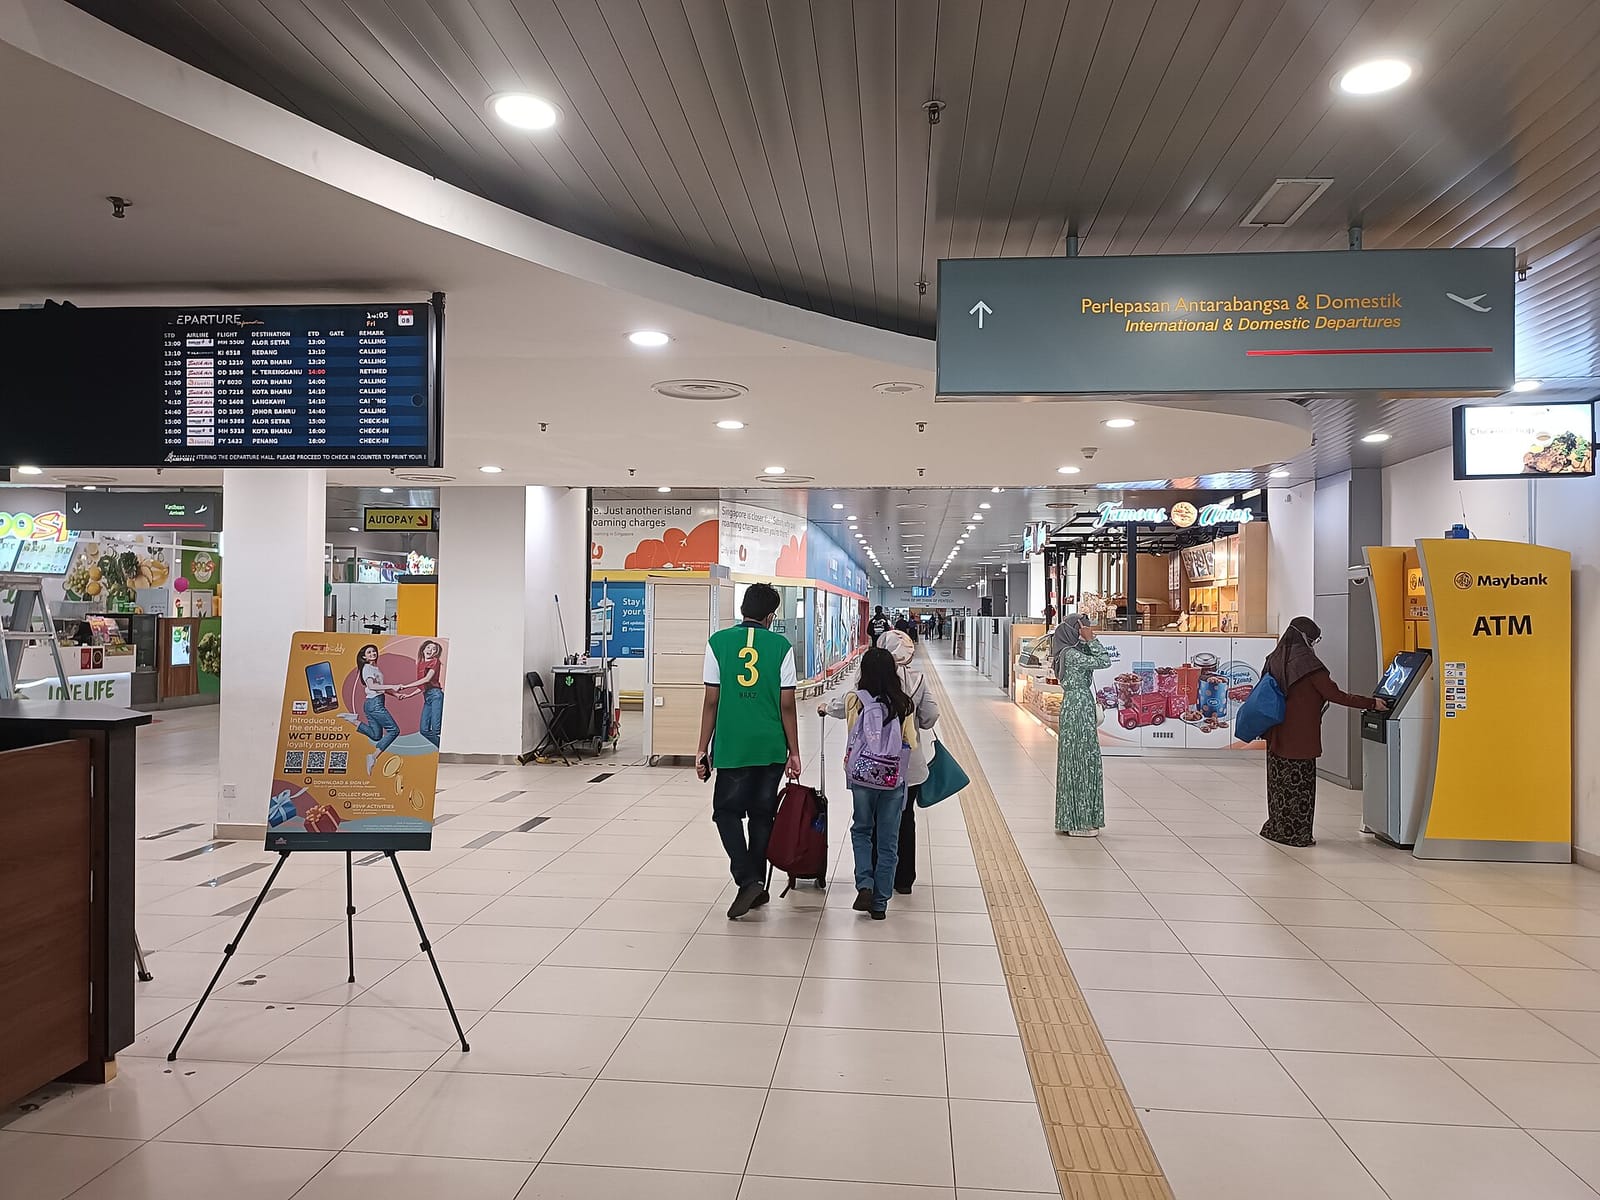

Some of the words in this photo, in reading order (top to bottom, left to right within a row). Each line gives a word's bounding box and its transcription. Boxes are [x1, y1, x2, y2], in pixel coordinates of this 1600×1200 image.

[1081, 298, 1170, 317] Perlepasan
[1174, 295, 1290, 315] Antarabangsa
[1295, 295, 1310, 310] &
[1315, 292, 1402, 310] Domestik
[168, 314, 242, 325] EPARTURE
[1125, 318, 1219, 332] International
[1222, 318, 1234, 331] &
[1238, 317, 1311, 331] Domestic
[1315, 316, 1401, 331] Departures
[592, 507, 602, 515] e.
[603, 506, 624, 515] Just
[625, 506, 662, 515] another
[664, 506, 692, 515] island
[721, 506, 746, 519] Singapore
[1093, 501, 1168, 528] Famous
[1199, 503, 1254, 527] Amos
[367, 515, 414, 524] AUTOPAY
[592, 518, 627, 529] oaming
[629, 518, 666, 529] charges
[721, 520, 742, 531] roaming
[1477, 573, 1548, 589] Maybank
[622, 598, 640, 607] Stay
[622, 609, 641, 617] your
[1472, 615, 1533, 637] ATM
[736, 646, 760, 687] 3
[85, 680, 116, 700] LIFE
[290, 717, 336, 725] Introducing
[288, 732, 313, 740] WCT
[314, 732, 351, 741] BUDDY
[287, 740, 314, 749] loyalty
